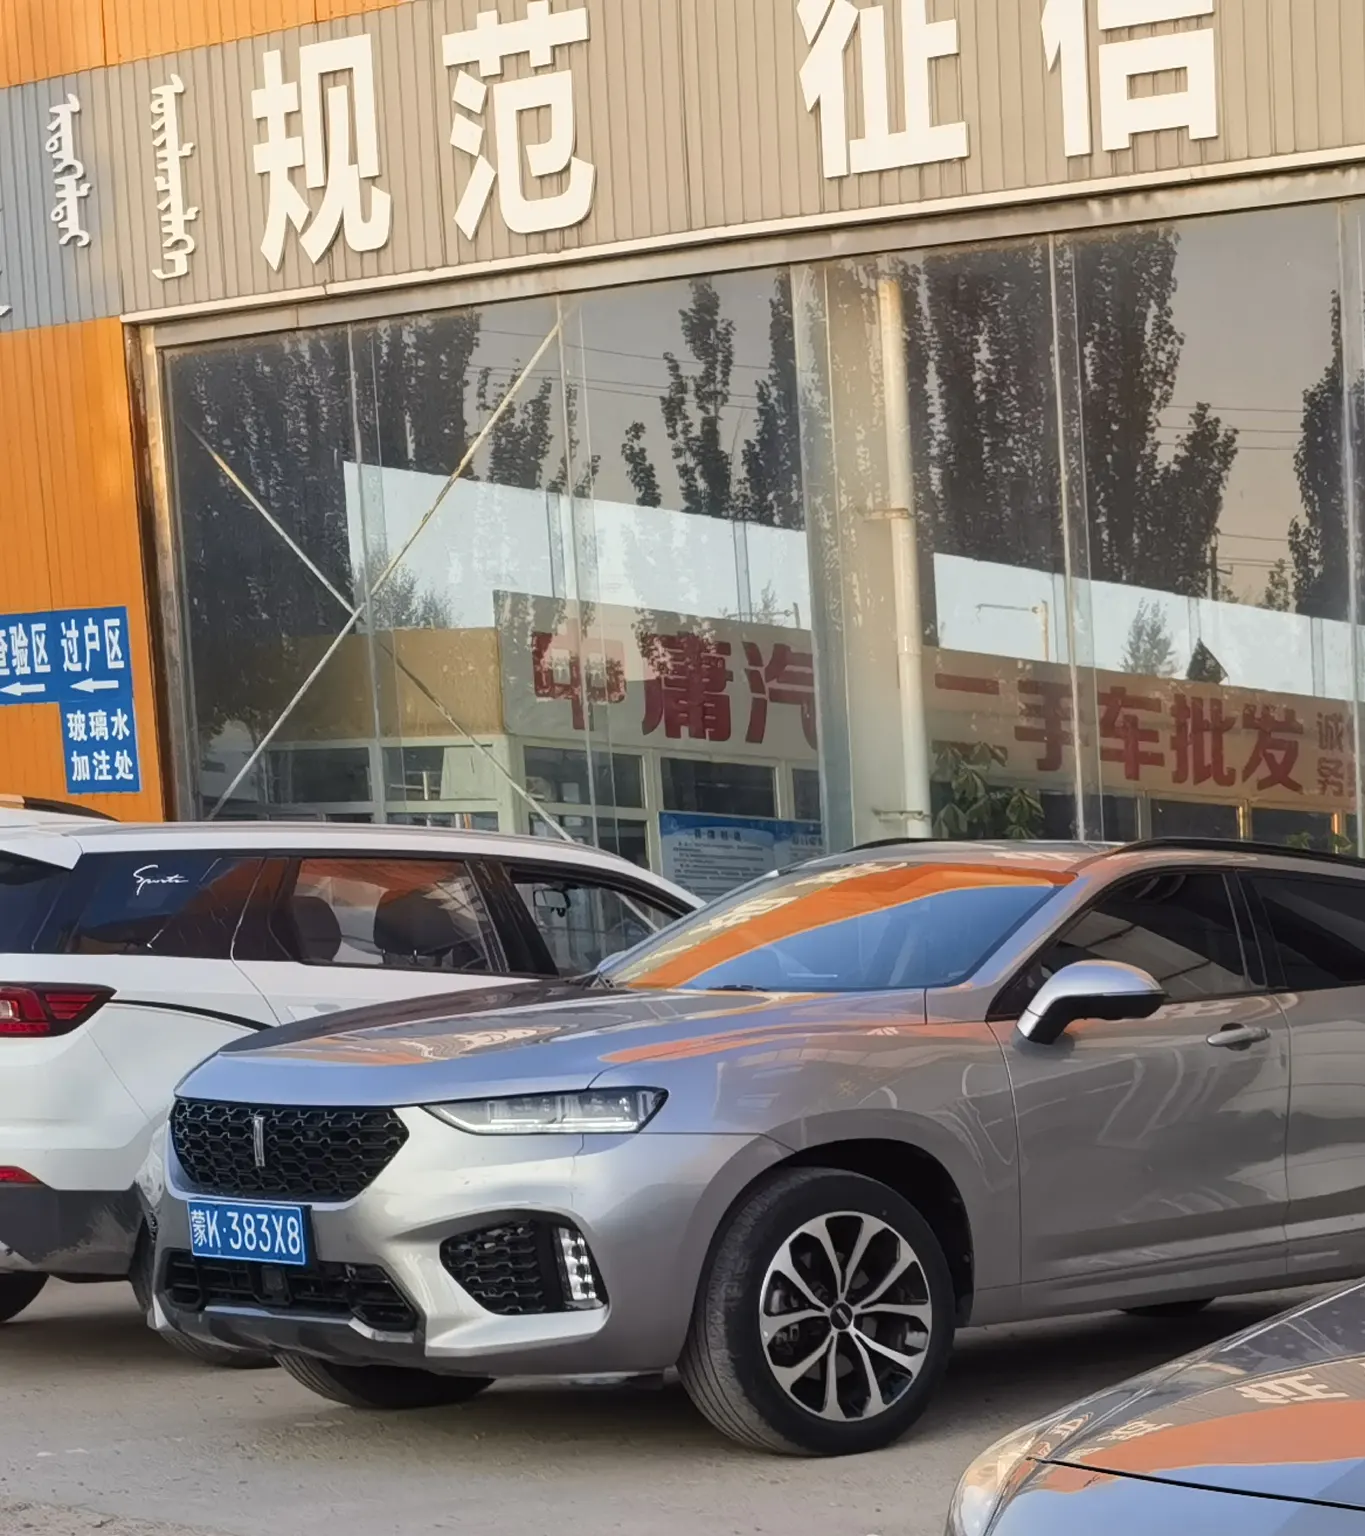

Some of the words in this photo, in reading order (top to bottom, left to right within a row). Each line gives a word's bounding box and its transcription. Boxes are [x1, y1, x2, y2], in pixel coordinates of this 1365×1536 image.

[250, 0, 596, 272] 规范
[797, 0, 1219, 179] 征信
[61, 617, 125, 672] 过户区
[66, 708, 130, 742] 玻璃水
[71, 749, 134, 782] 加注处
